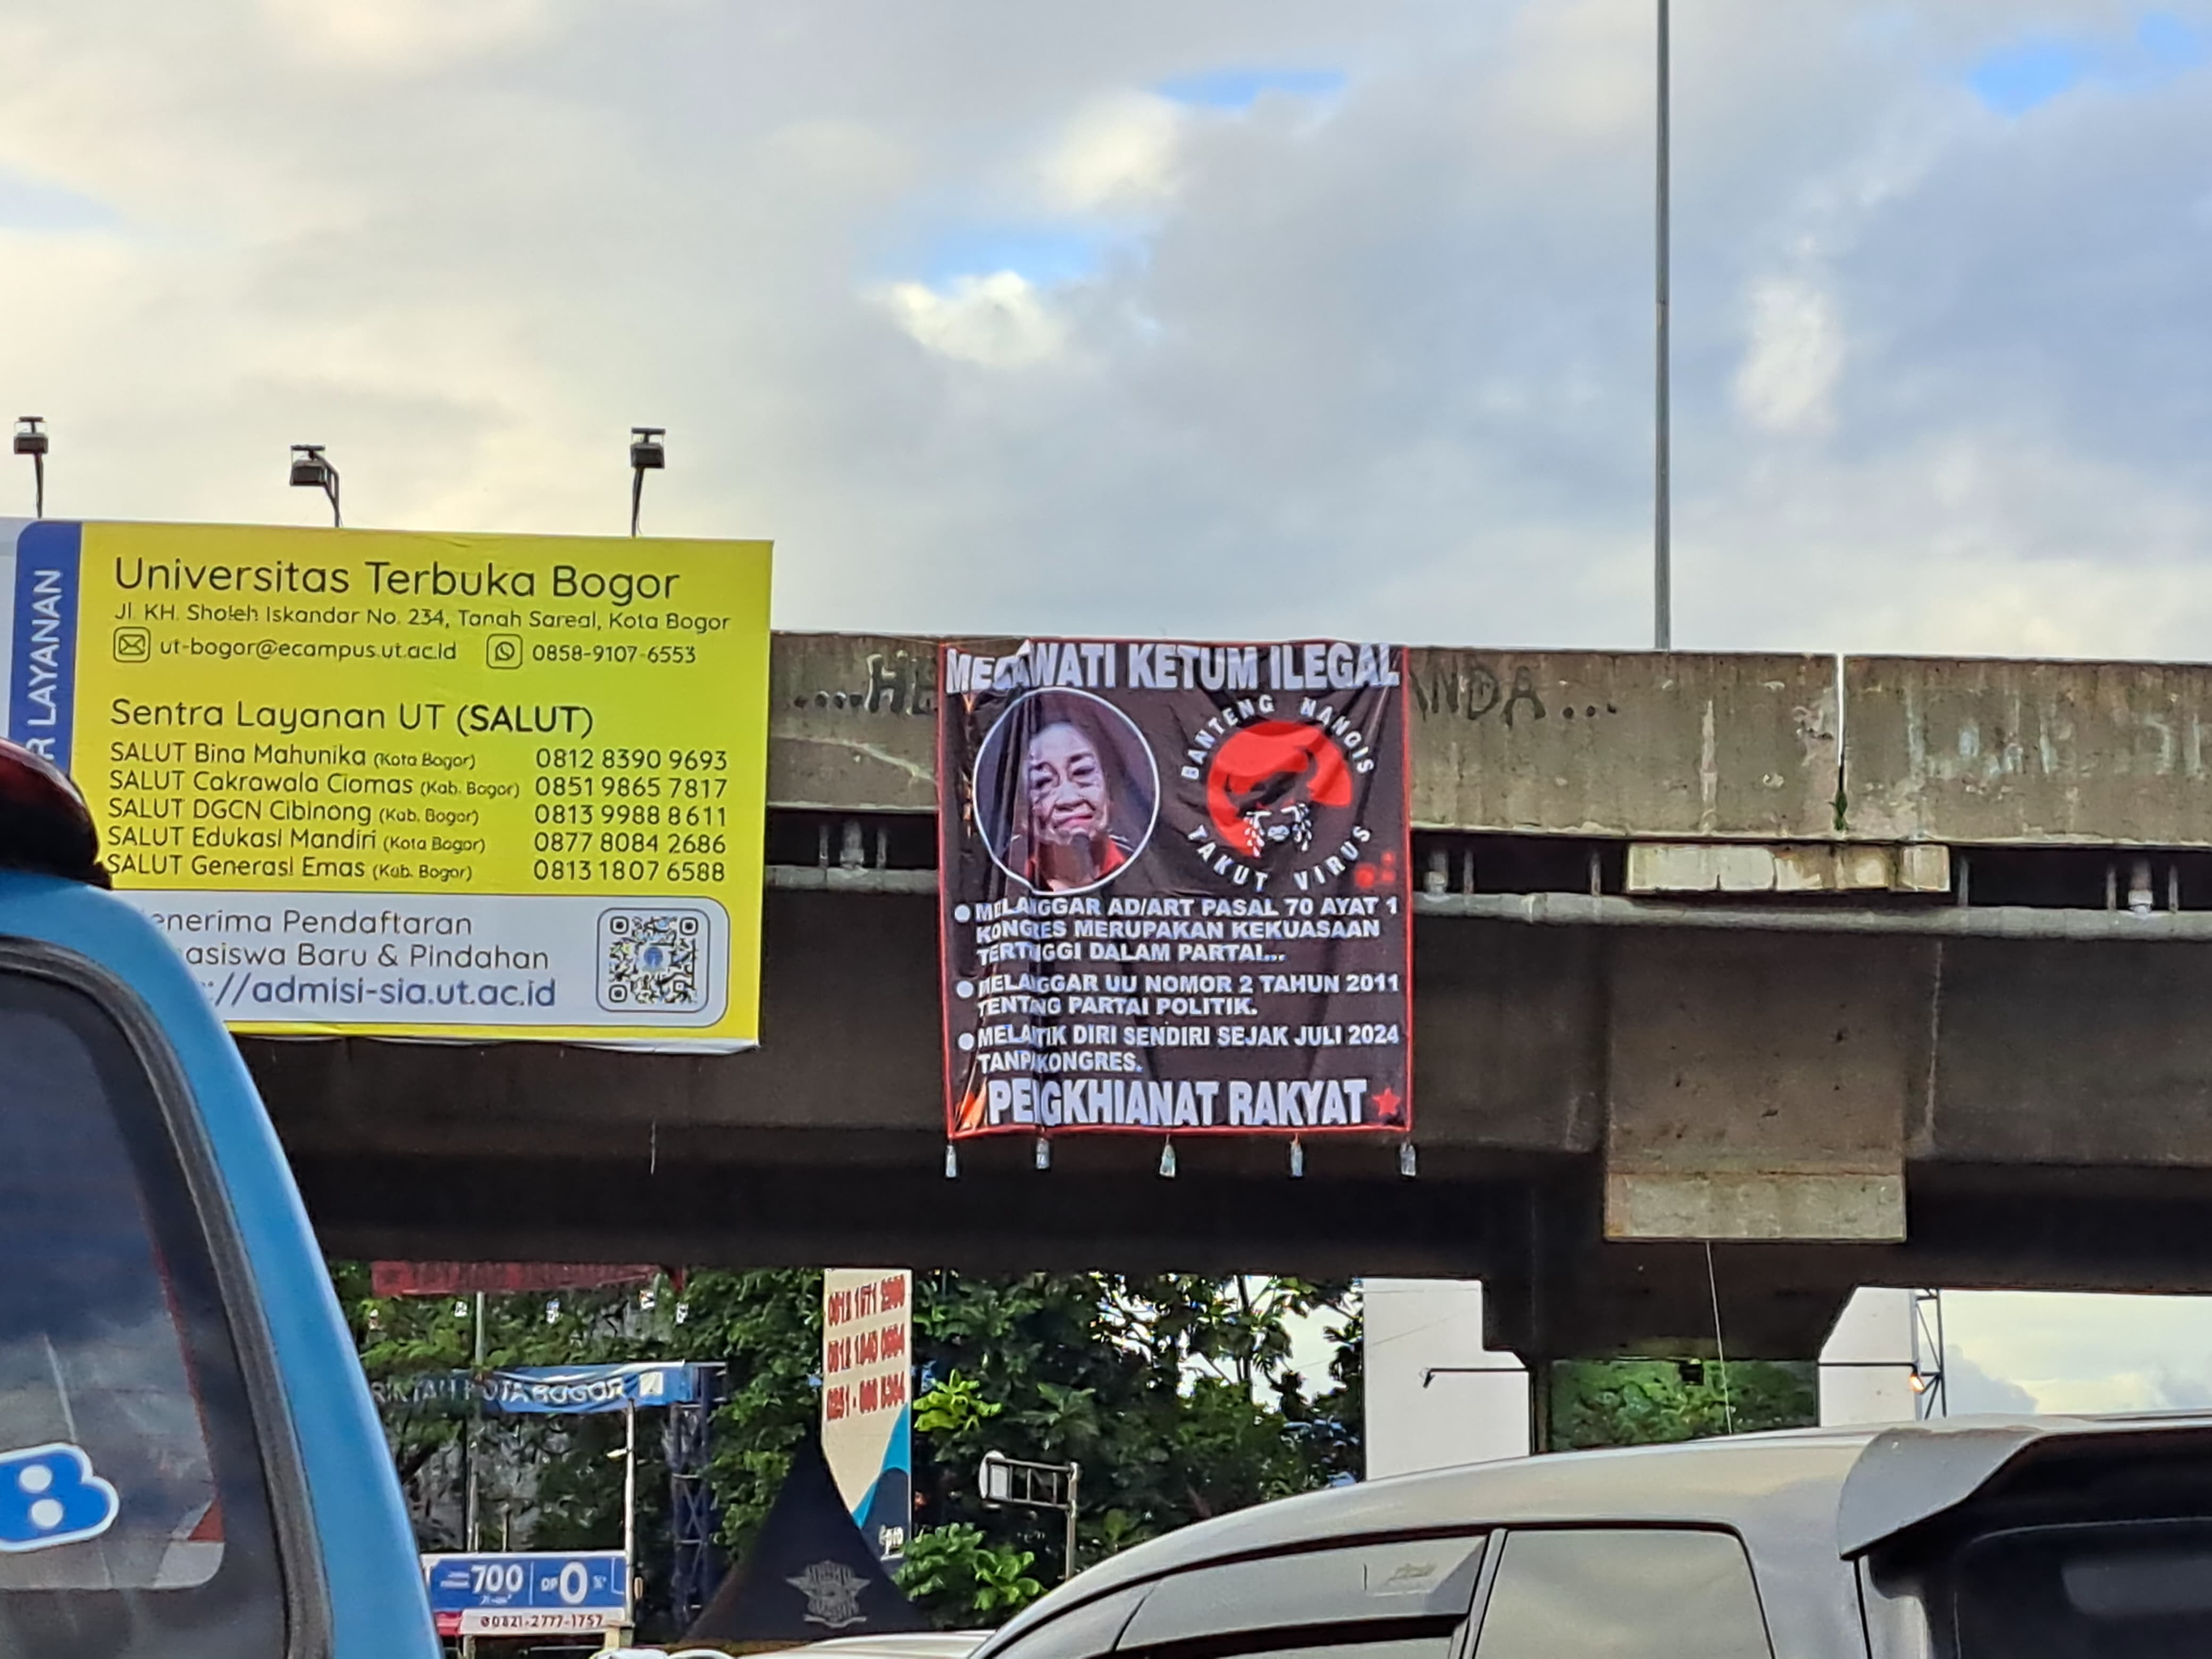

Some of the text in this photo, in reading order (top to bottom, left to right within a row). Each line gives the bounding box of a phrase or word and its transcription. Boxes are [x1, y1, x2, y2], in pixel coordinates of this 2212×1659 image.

[115, 557, 680, 606] Universitas Terbuka Bogor
[187, 604, 258, 621] Sholeh
[267, 606, 359, 624] Iskandar
[408, 608, 449, 628] 234,
[458, 610, 521, 627] Tanah
[529, 611, 601, 630] Sareal,
[610, 613, 658, 629] Kota
[666, 614, 731, 633] Bogor
[27, 570, 62, 725] LAYANAN
[161, 638, 696, 664] ut-bogor@ecampus.ut.ac.id 0858-9107-6553
[946, 642, 1400, 693] MEGAWATI KETUM ILEGAL
[110, 699, 593, 739] Sentra Layanan UT (SALUT)
[1180, 694, 1374, 780] BANTENG NANGIS
[110, 742, 727, 771] SALUT Bina Mahunika (Kota Bogor) 0812 8390 9693
[110, 769, 727, 799] SALUT Cakrawala Ciomas (Kab. Bogor) 0851 9865 7817
[108, 798, 726, 827] SALUT DGCN Cibinong (Kab. Bogor) 0813 9988 8611
[107, 826, 726, 854] SALUT Edukasi Mandiri (Kota Bogor) 0877 8084 2686
[107, 854, 725, 882] SALUT Generasi Emas (Kab. Bogor) 0813 1807 6588
[1294, 826, 1371, 890] VIRUS
[1108, 898, 1194, 916] AD/ART
[1202, 898, 1279, 917] PASAL
[1284, 898, 1313, 916] 70
[1320, 897, 1379, 916] AYAT
[1386, 896, 1397, 915] 1
[150, 909, 472, 936] enerima Pendaftaran
[1074, 920, 1223, 940] MERUPAKAN
[1232, 920, 1379, 940] KEKUASAAN
[298, 943, 366, 967] Baru
[378, 943, 398, 967] &
[410, 944, 549, 969] Pindahan
[1090, 942, 1169, 961] DALAM
[1105, 975, 1137, 993] UU
[1145, 975, 1232, 993] NOMOR
[1239, 975, 1253, 993] 2
[1260, 974, 1339, 993] TAHUN
[1346, 974, 1399, 992] 2011
[1068, 997, 1149, 1016] PARTAI
[1156, 998, 1258, 1015] POLITIK.
[1074, 1025, 1116, 1045] DIRI
[1123, 1026, 1210, 1046] SENDIRI
[1217, 1026, 1288, 1046] SEJAK
[1294, 1025, 1342, 1046] JULI
[1348, 1025, 1400, 1045] 2024
[1228, 1078, 1367, 1126] RAKYAT
[471, 1563, 524, 1594] 700
[559, 1561, 588, 1605] 0
